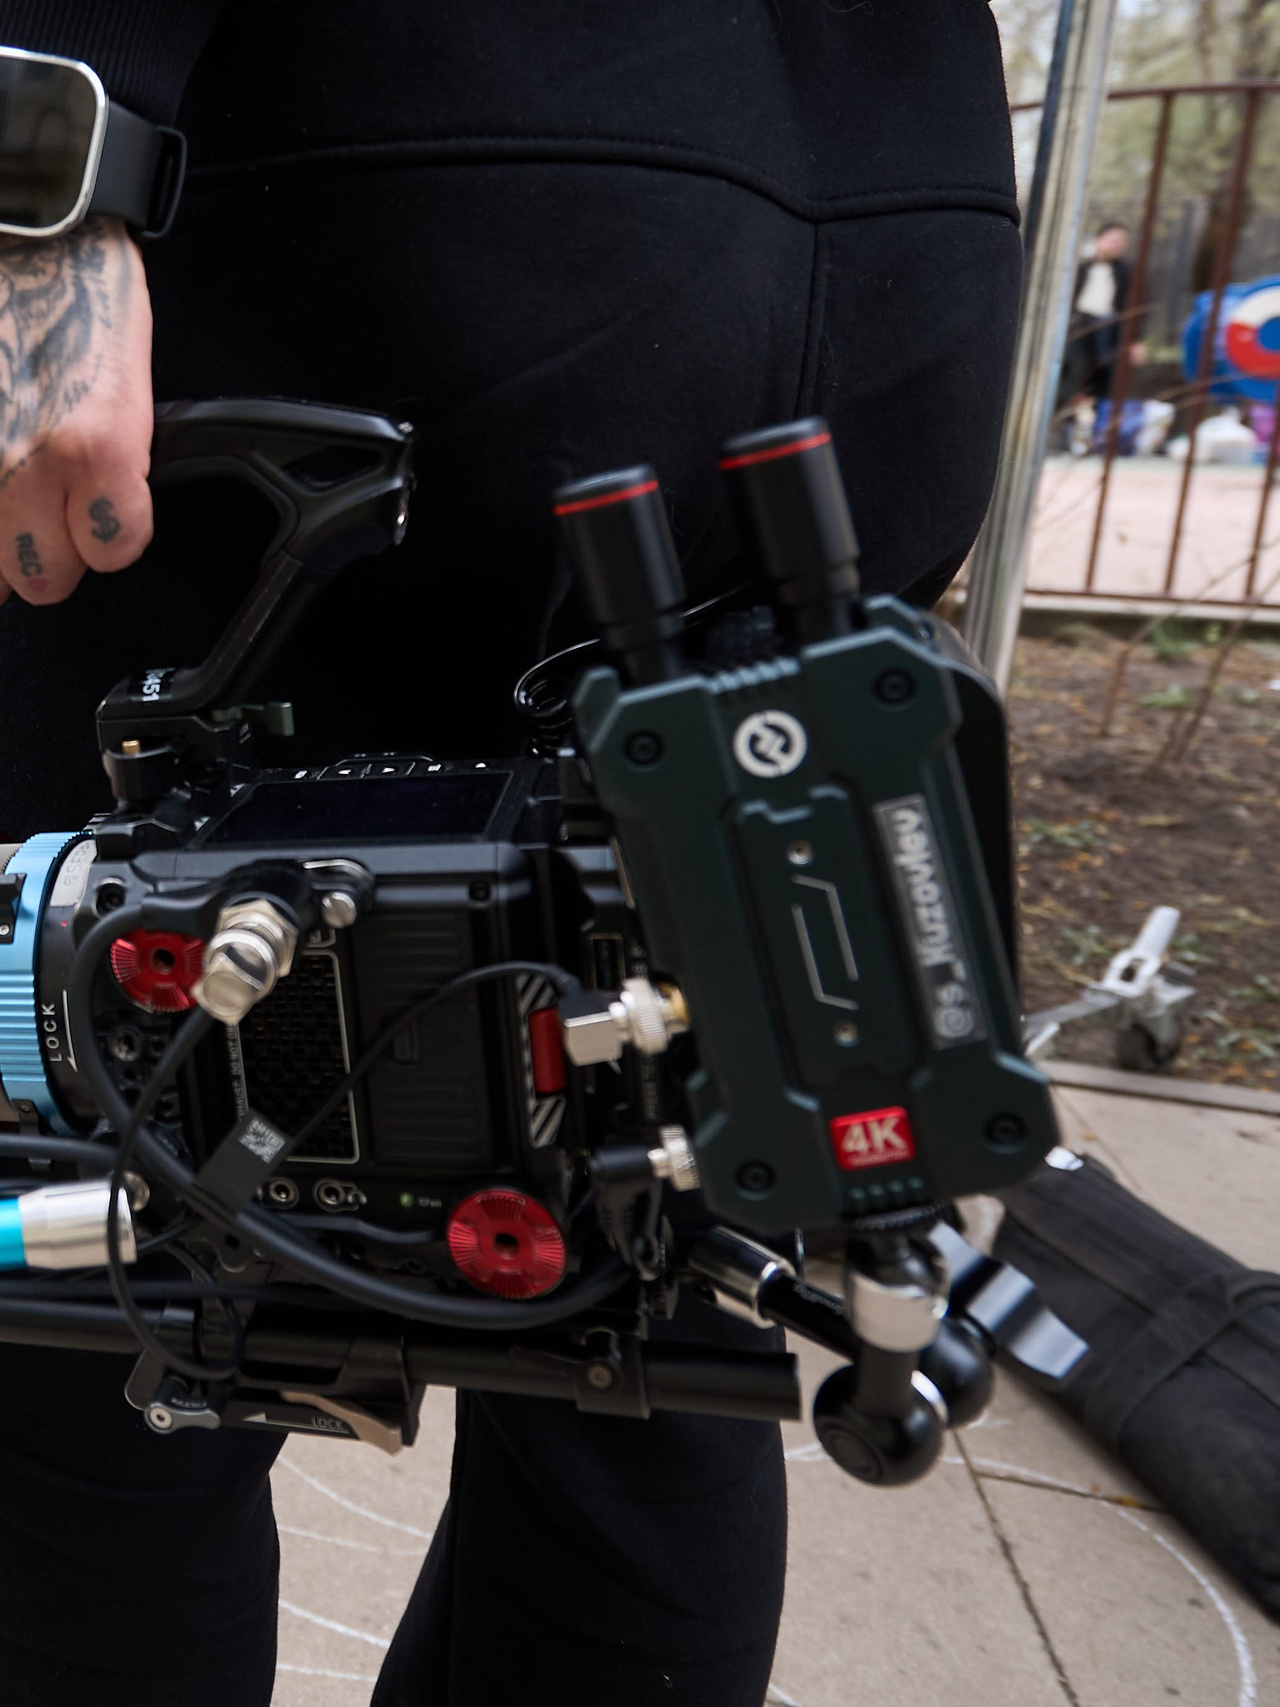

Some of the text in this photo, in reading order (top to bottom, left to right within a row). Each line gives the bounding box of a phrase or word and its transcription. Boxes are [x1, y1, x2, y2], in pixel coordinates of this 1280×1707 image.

[14, 532, 44, 577] REC
[141, 672, 162, 702] 451
[42, 1001, 63, 1063] LOCK
[841, 1116, 907, 1153] 4K
[311, 1416, 344, 1430] LOCK
